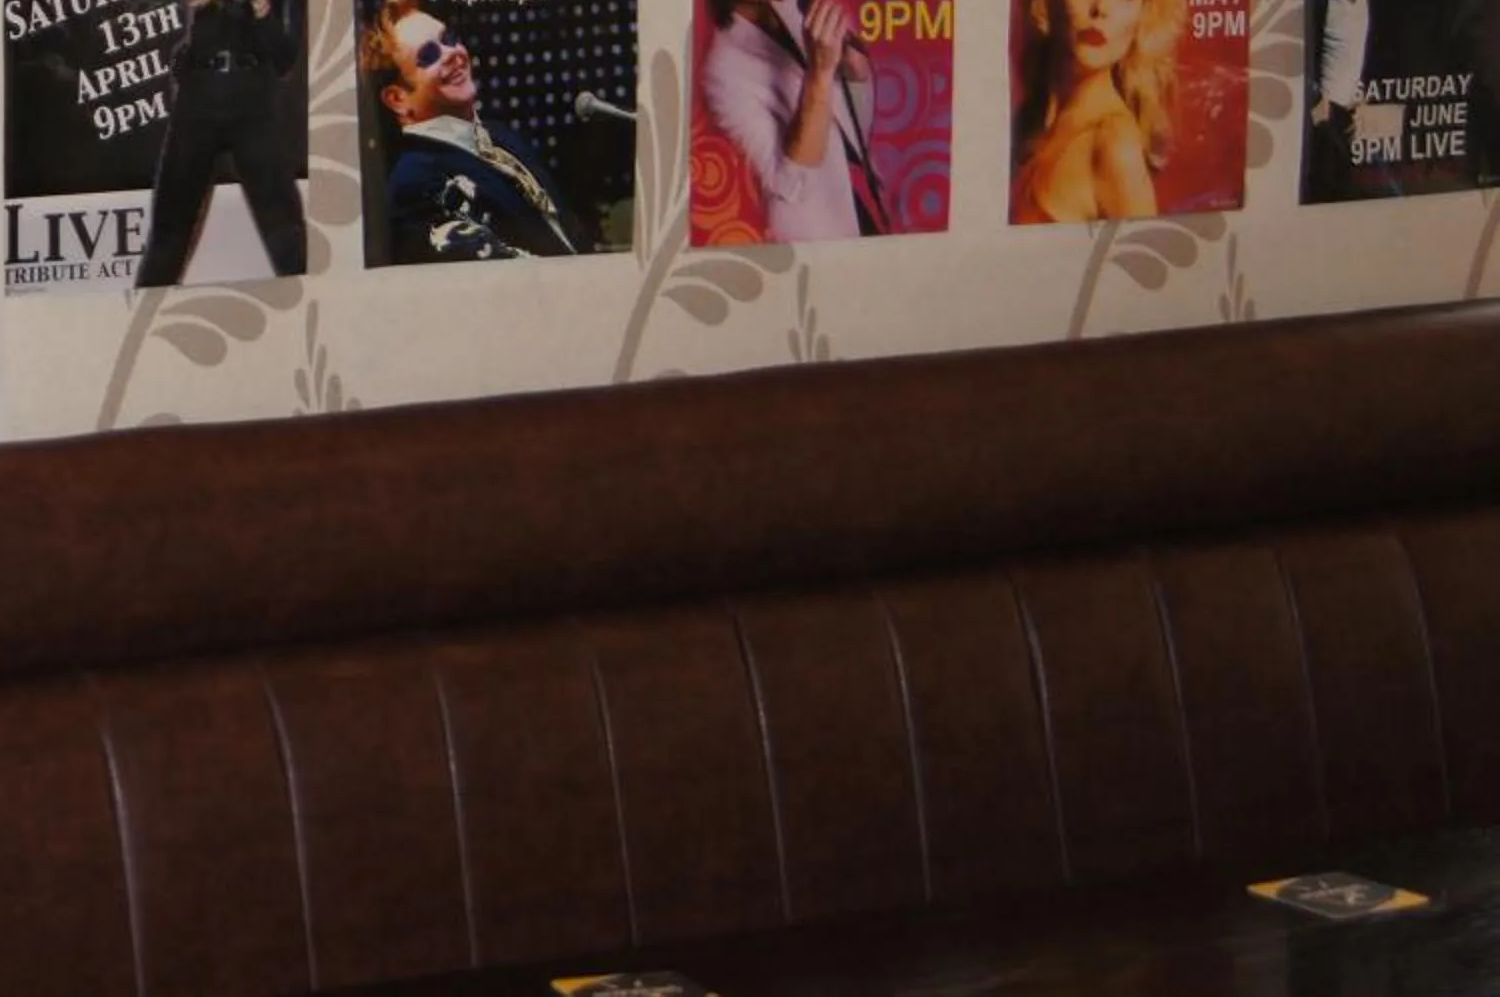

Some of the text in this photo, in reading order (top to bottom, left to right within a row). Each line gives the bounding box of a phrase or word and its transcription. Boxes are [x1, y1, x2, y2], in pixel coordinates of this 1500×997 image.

[98, 2, 183, 55] 13TH
[858, 0, 952, 43] 9PM
[1192, 10, 1246, 39] 9PM
[77, 49, 171, 104] APRIL
[1352, 73, 1474, 101] SATURDAY
[92, 91, 171, 141] 9PM
[1409, 102, 1469, 127] JUNE
[1351, 130, 1467, 165] 9PM LIVE
[4, 203, 147, 265] LIVE
[4, 260, 135, 286] TRIBUTE ACT
